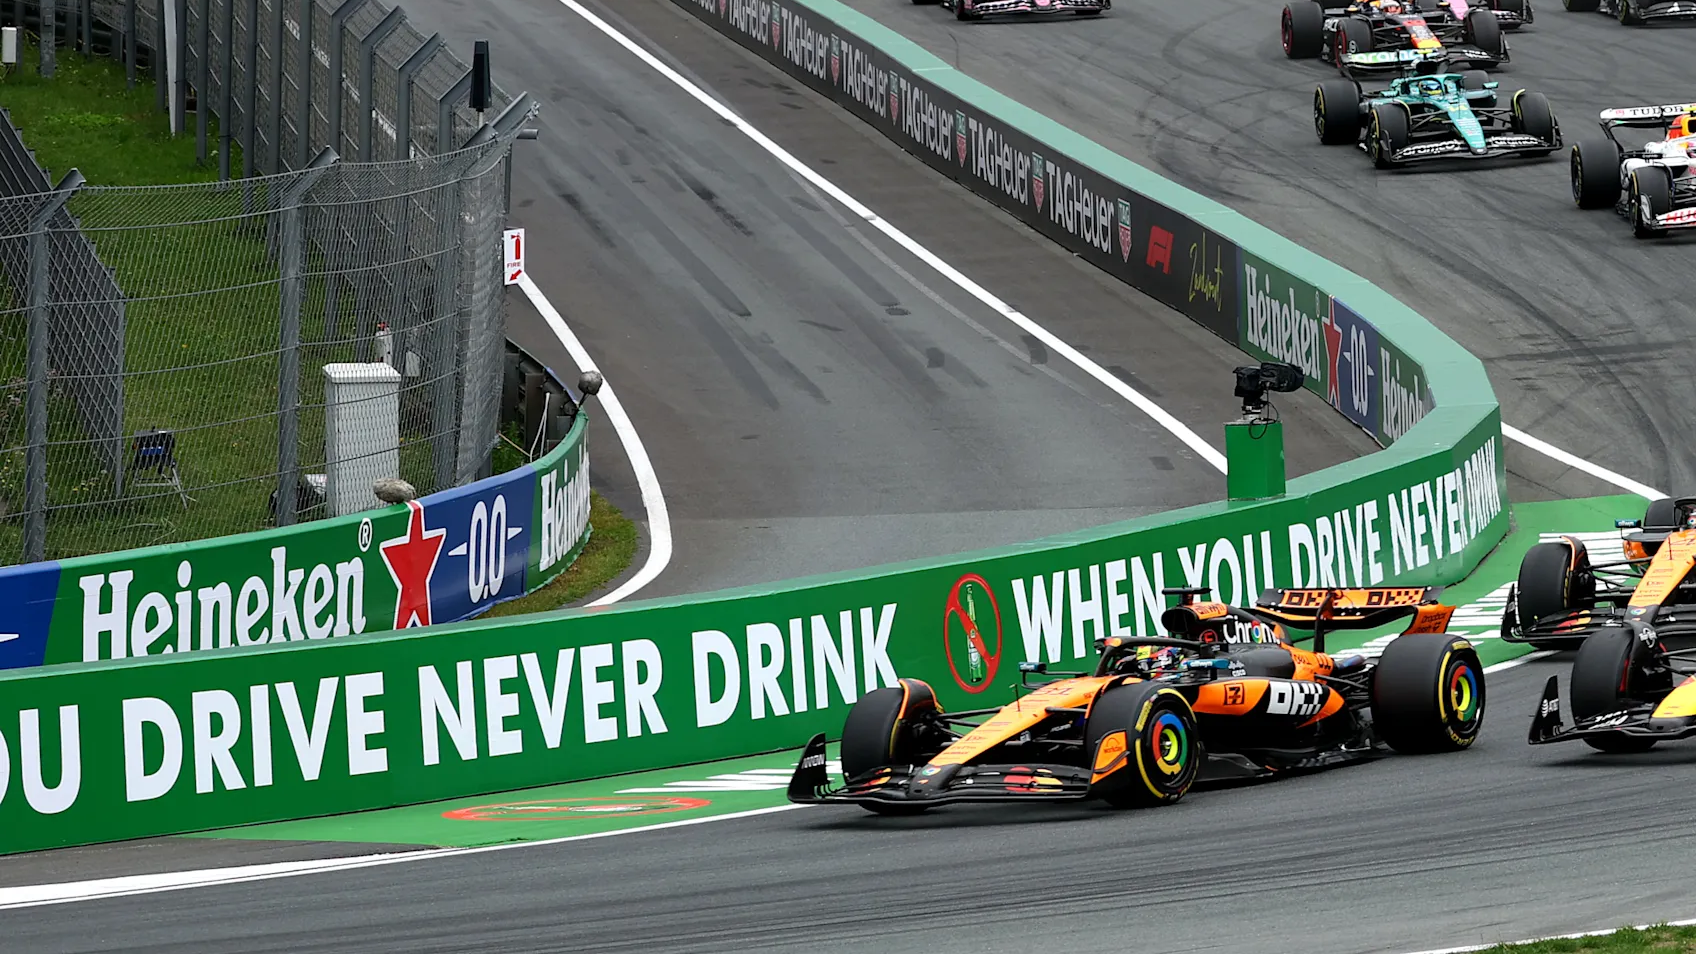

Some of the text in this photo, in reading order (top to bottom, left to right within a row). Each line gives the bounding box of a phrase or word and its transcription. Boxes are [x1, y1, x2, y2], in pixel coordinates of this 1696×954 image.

[1245, 263, 1370, 417] Heineken 0.0
[0, 435, 1501, 814] U DRIVE NEVER DRINK WHEN YOU DRIVE NEVER DRINK
[79, 494, 507, 662] Heineken 0.0
